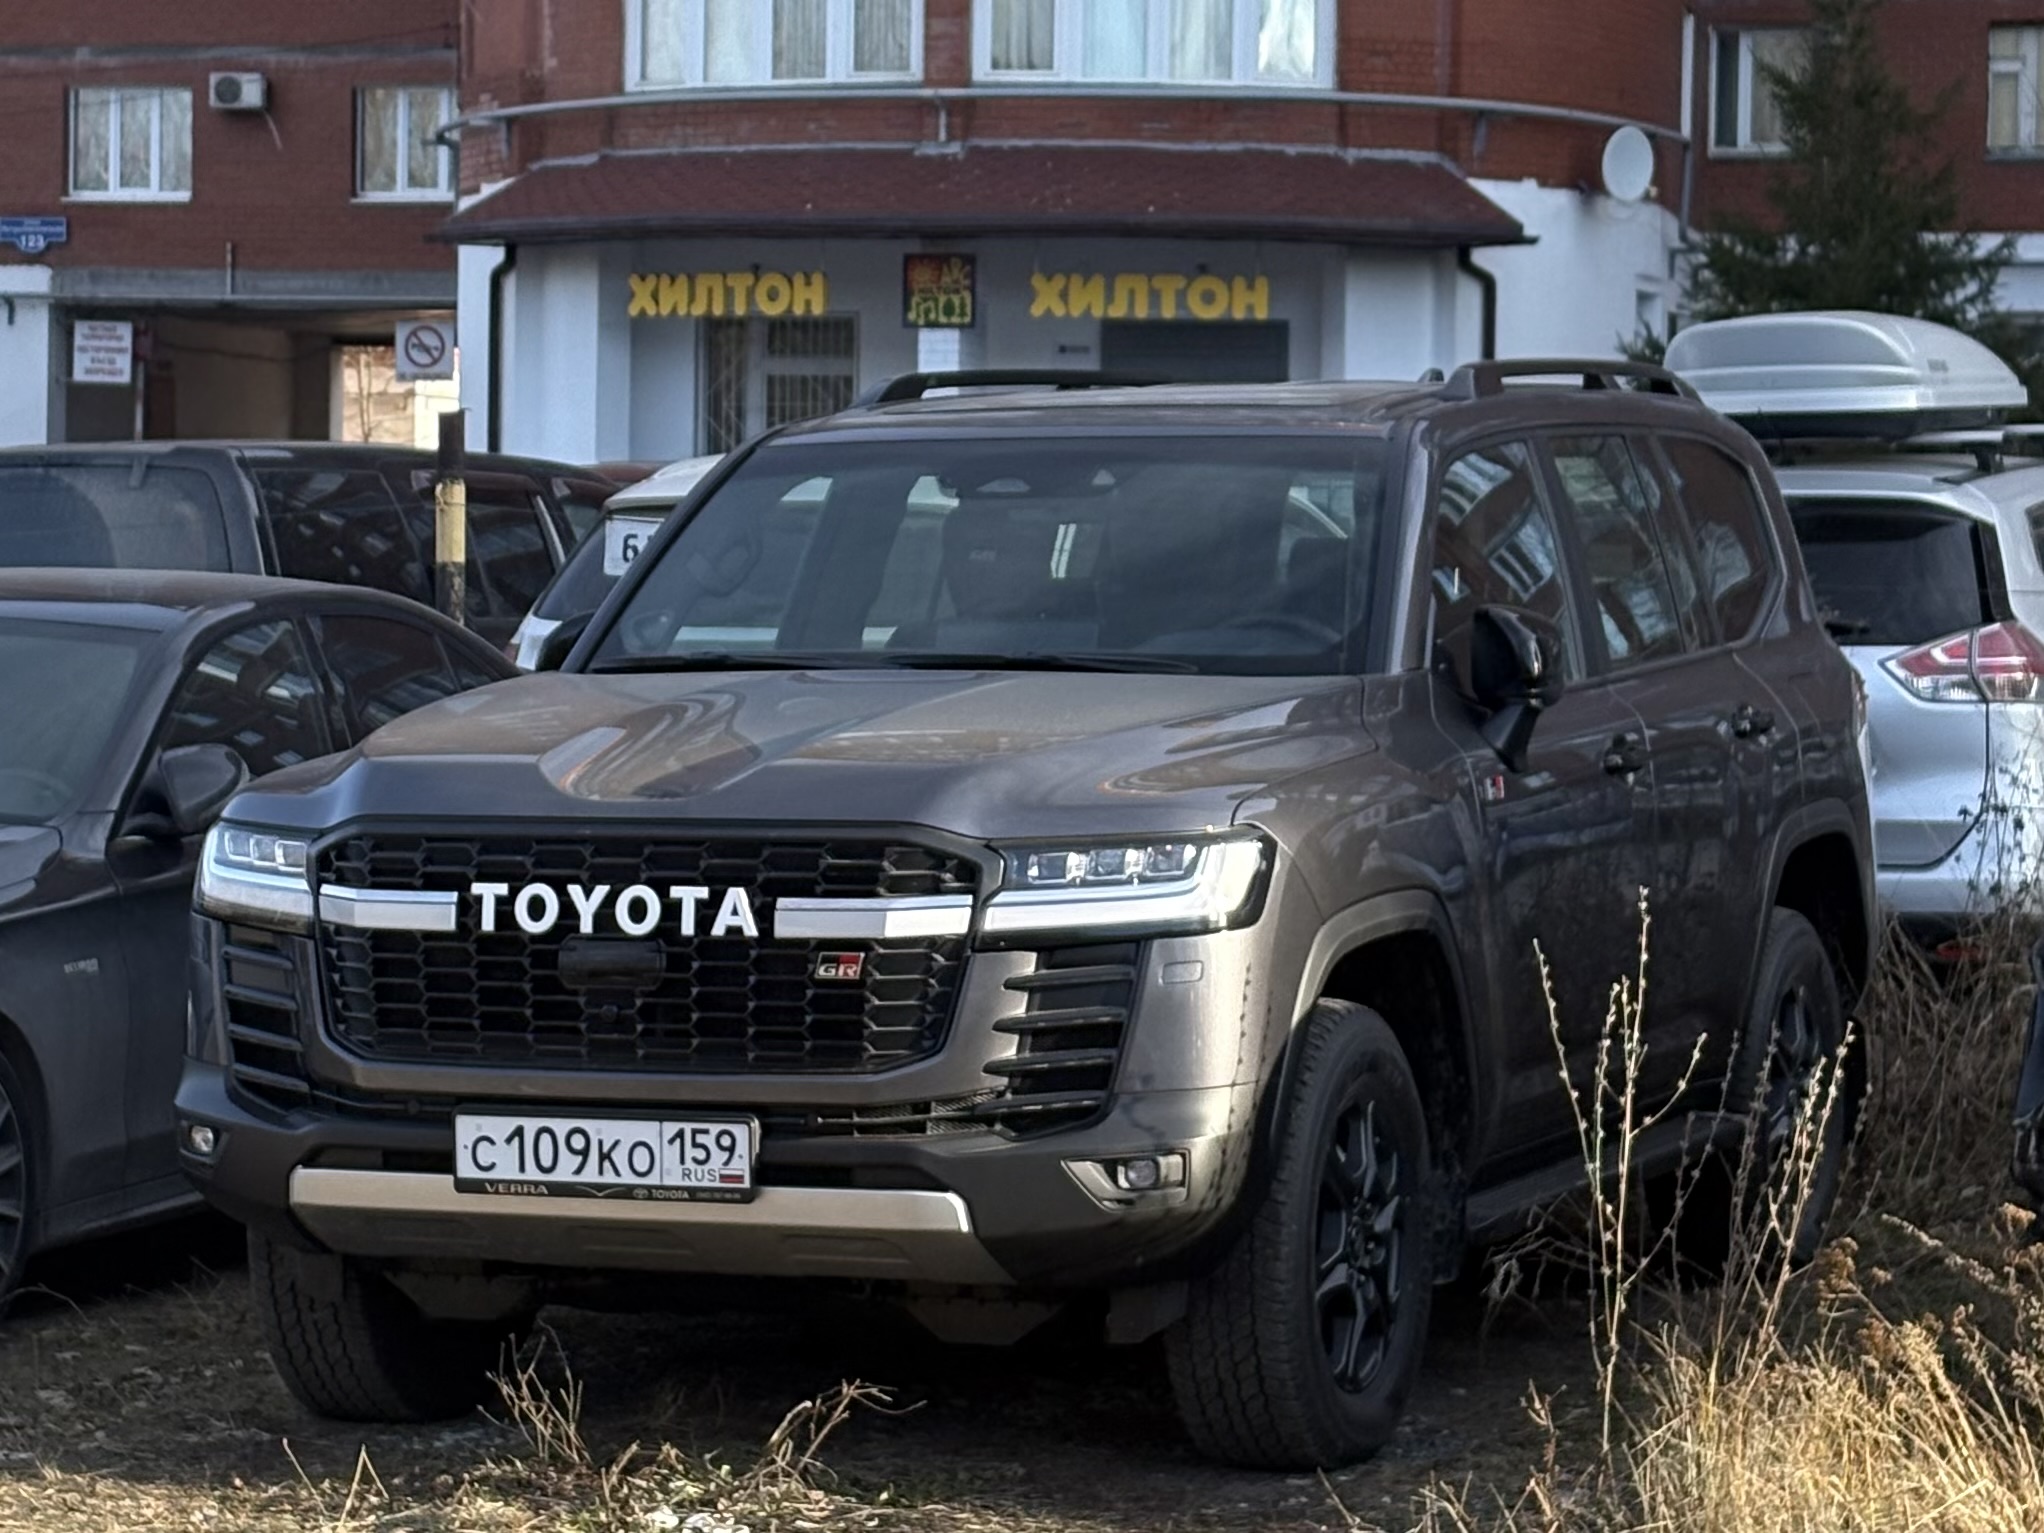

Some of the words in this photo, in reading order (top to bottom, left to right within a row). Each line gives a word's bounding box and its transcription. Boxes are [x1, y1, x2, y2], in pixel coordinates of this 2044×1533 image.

[20, 234, 44, 247] 123
[628, 272, 825, 316] ХИЛТОН
[1030, 272, 1269, 320] ХИЛТОН
[470, 882, 759, 937] TOYOTA
[667, 1127, 737, 1167] 159
[681, 1167, 717, 1182] RUS
[484, 1182, 549, 1195] VERRA
[651, 1189, 690, 1199] TOYOTA
